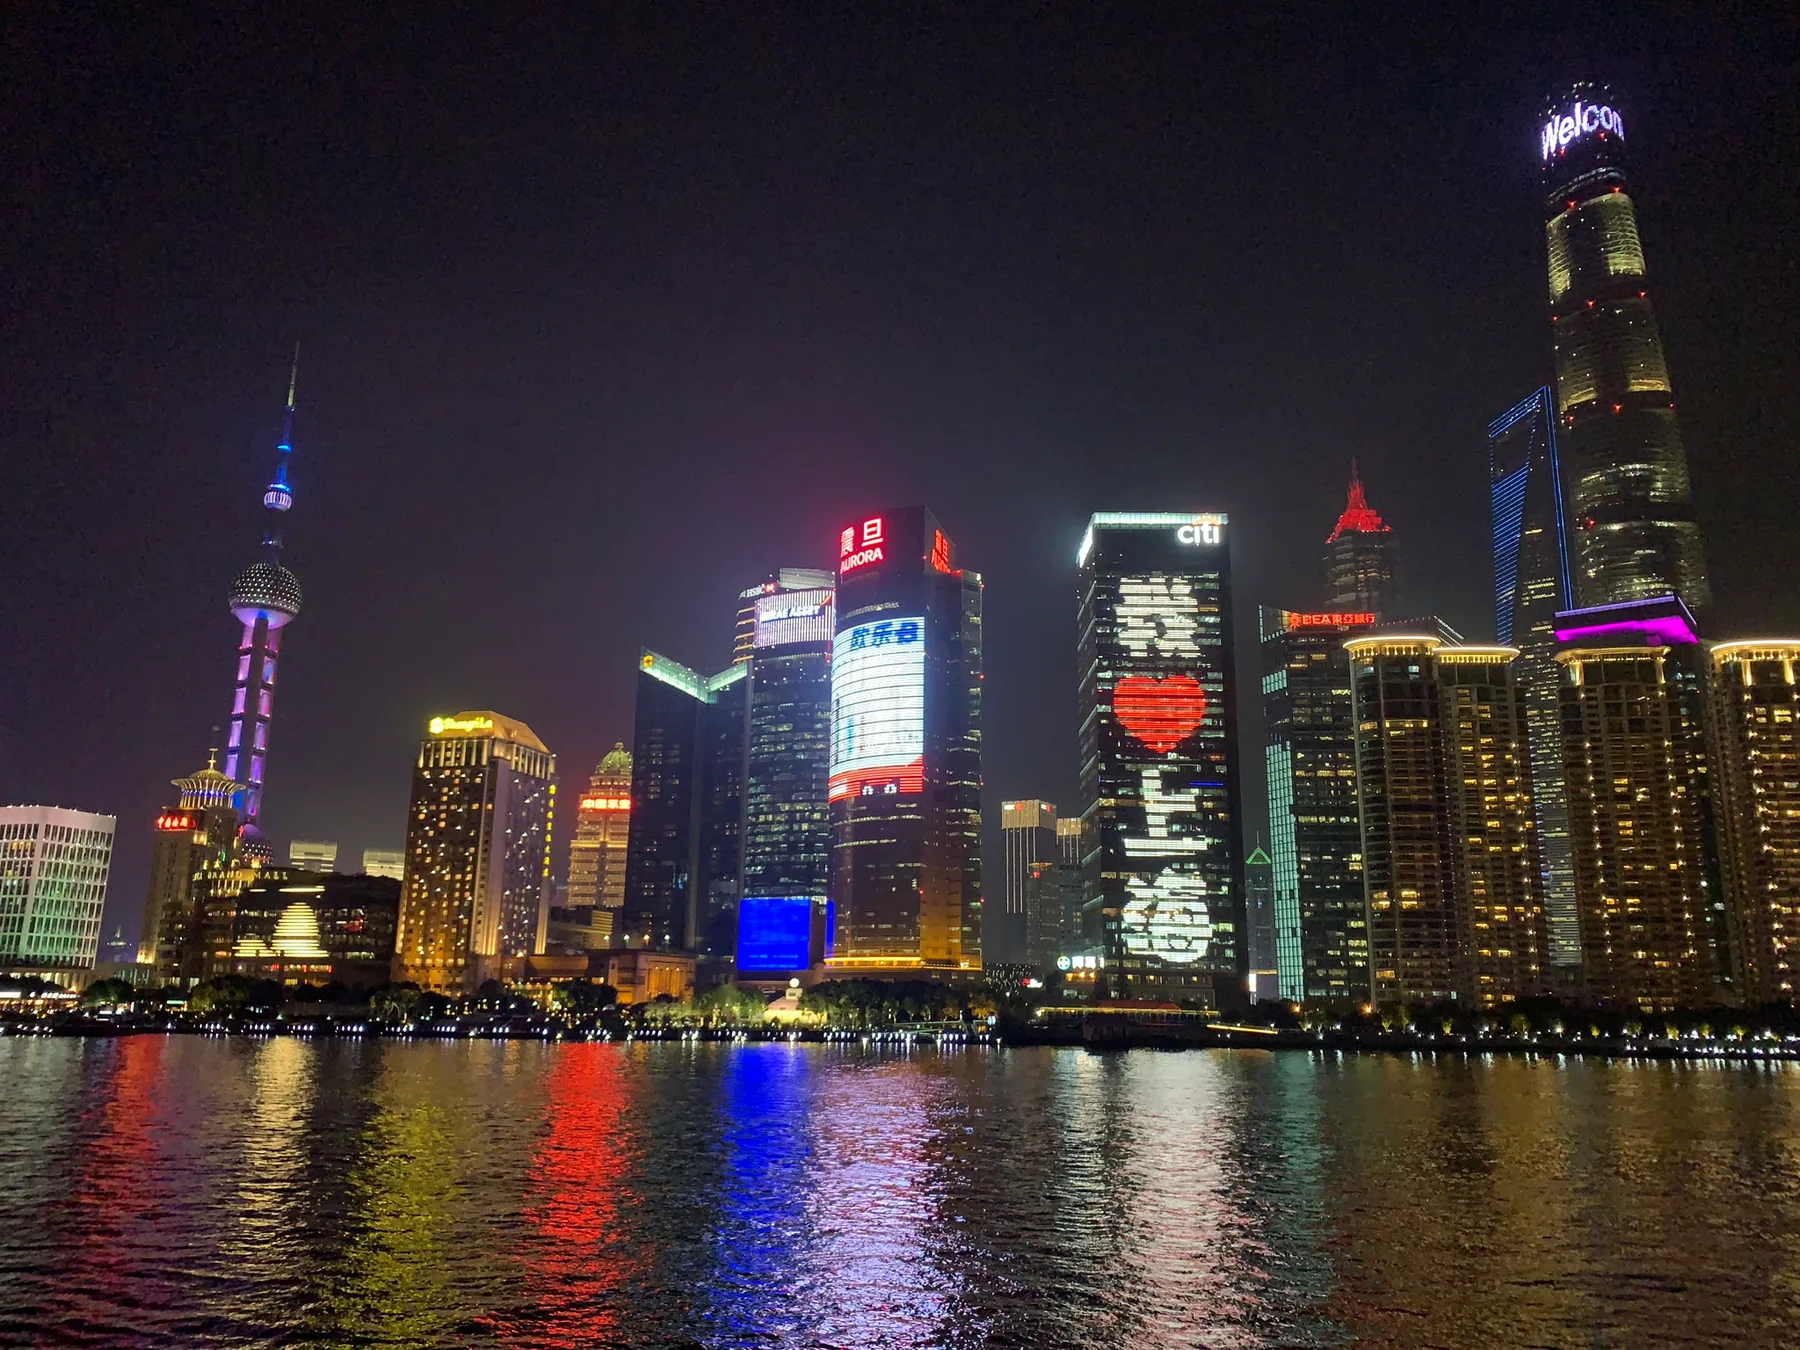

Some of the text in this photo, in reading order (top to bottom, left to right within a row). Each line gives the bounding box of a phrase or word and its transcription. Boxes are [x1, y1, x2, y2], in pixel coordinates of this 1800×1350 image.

[840, 517, 884, 558] 震旦
[1177, 521, 1220, 544] citi
[840, 547, 883, 575] AURORA
[746, 583, 765, 598] HSBC
[1302, 614, 1331, 625] BEA
